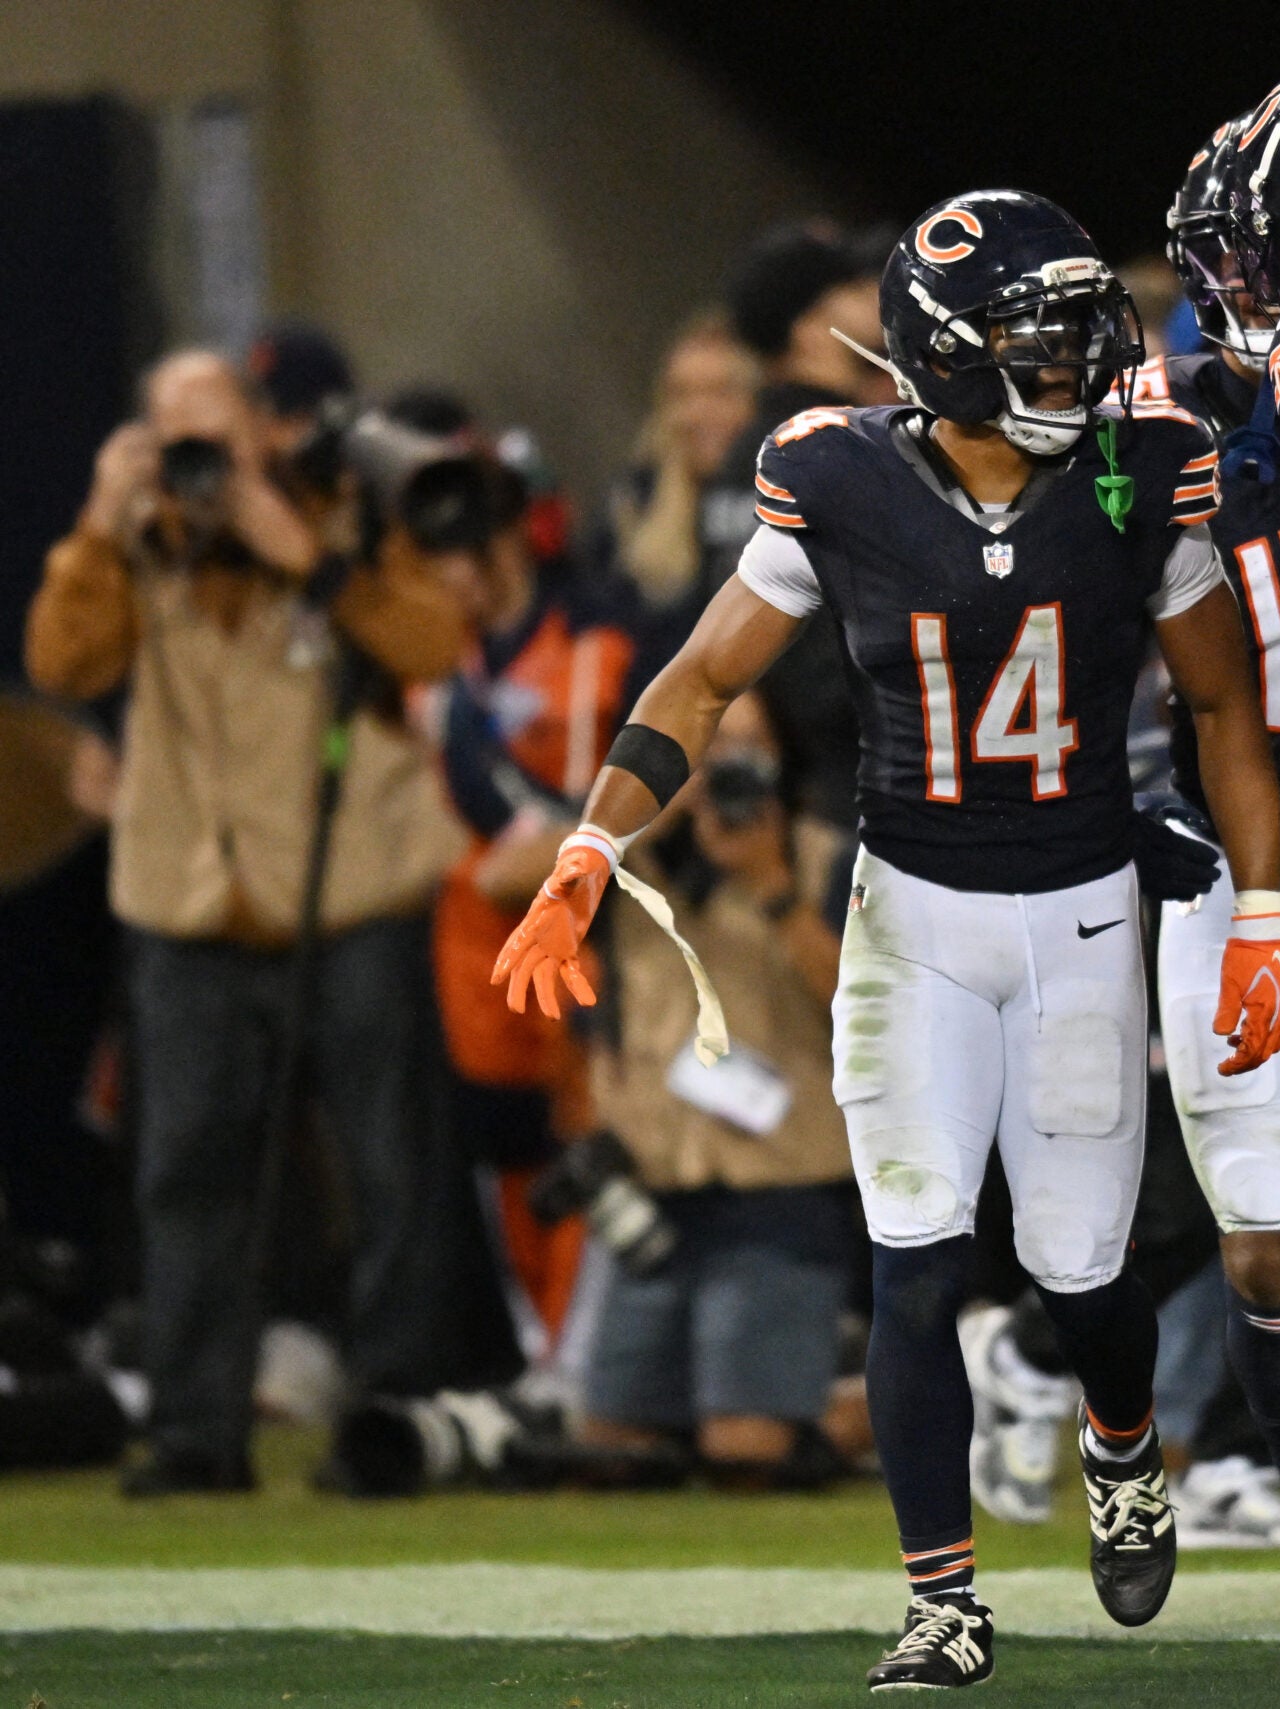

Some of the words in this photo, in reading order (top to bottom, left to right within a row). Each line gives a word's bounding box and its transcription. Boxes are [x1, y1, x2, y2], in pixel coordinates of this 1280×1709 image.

[915, 209, 982, 264] C
[988, 557, 1009, 571] NFL
[911, 600, 1081, 805] 14
